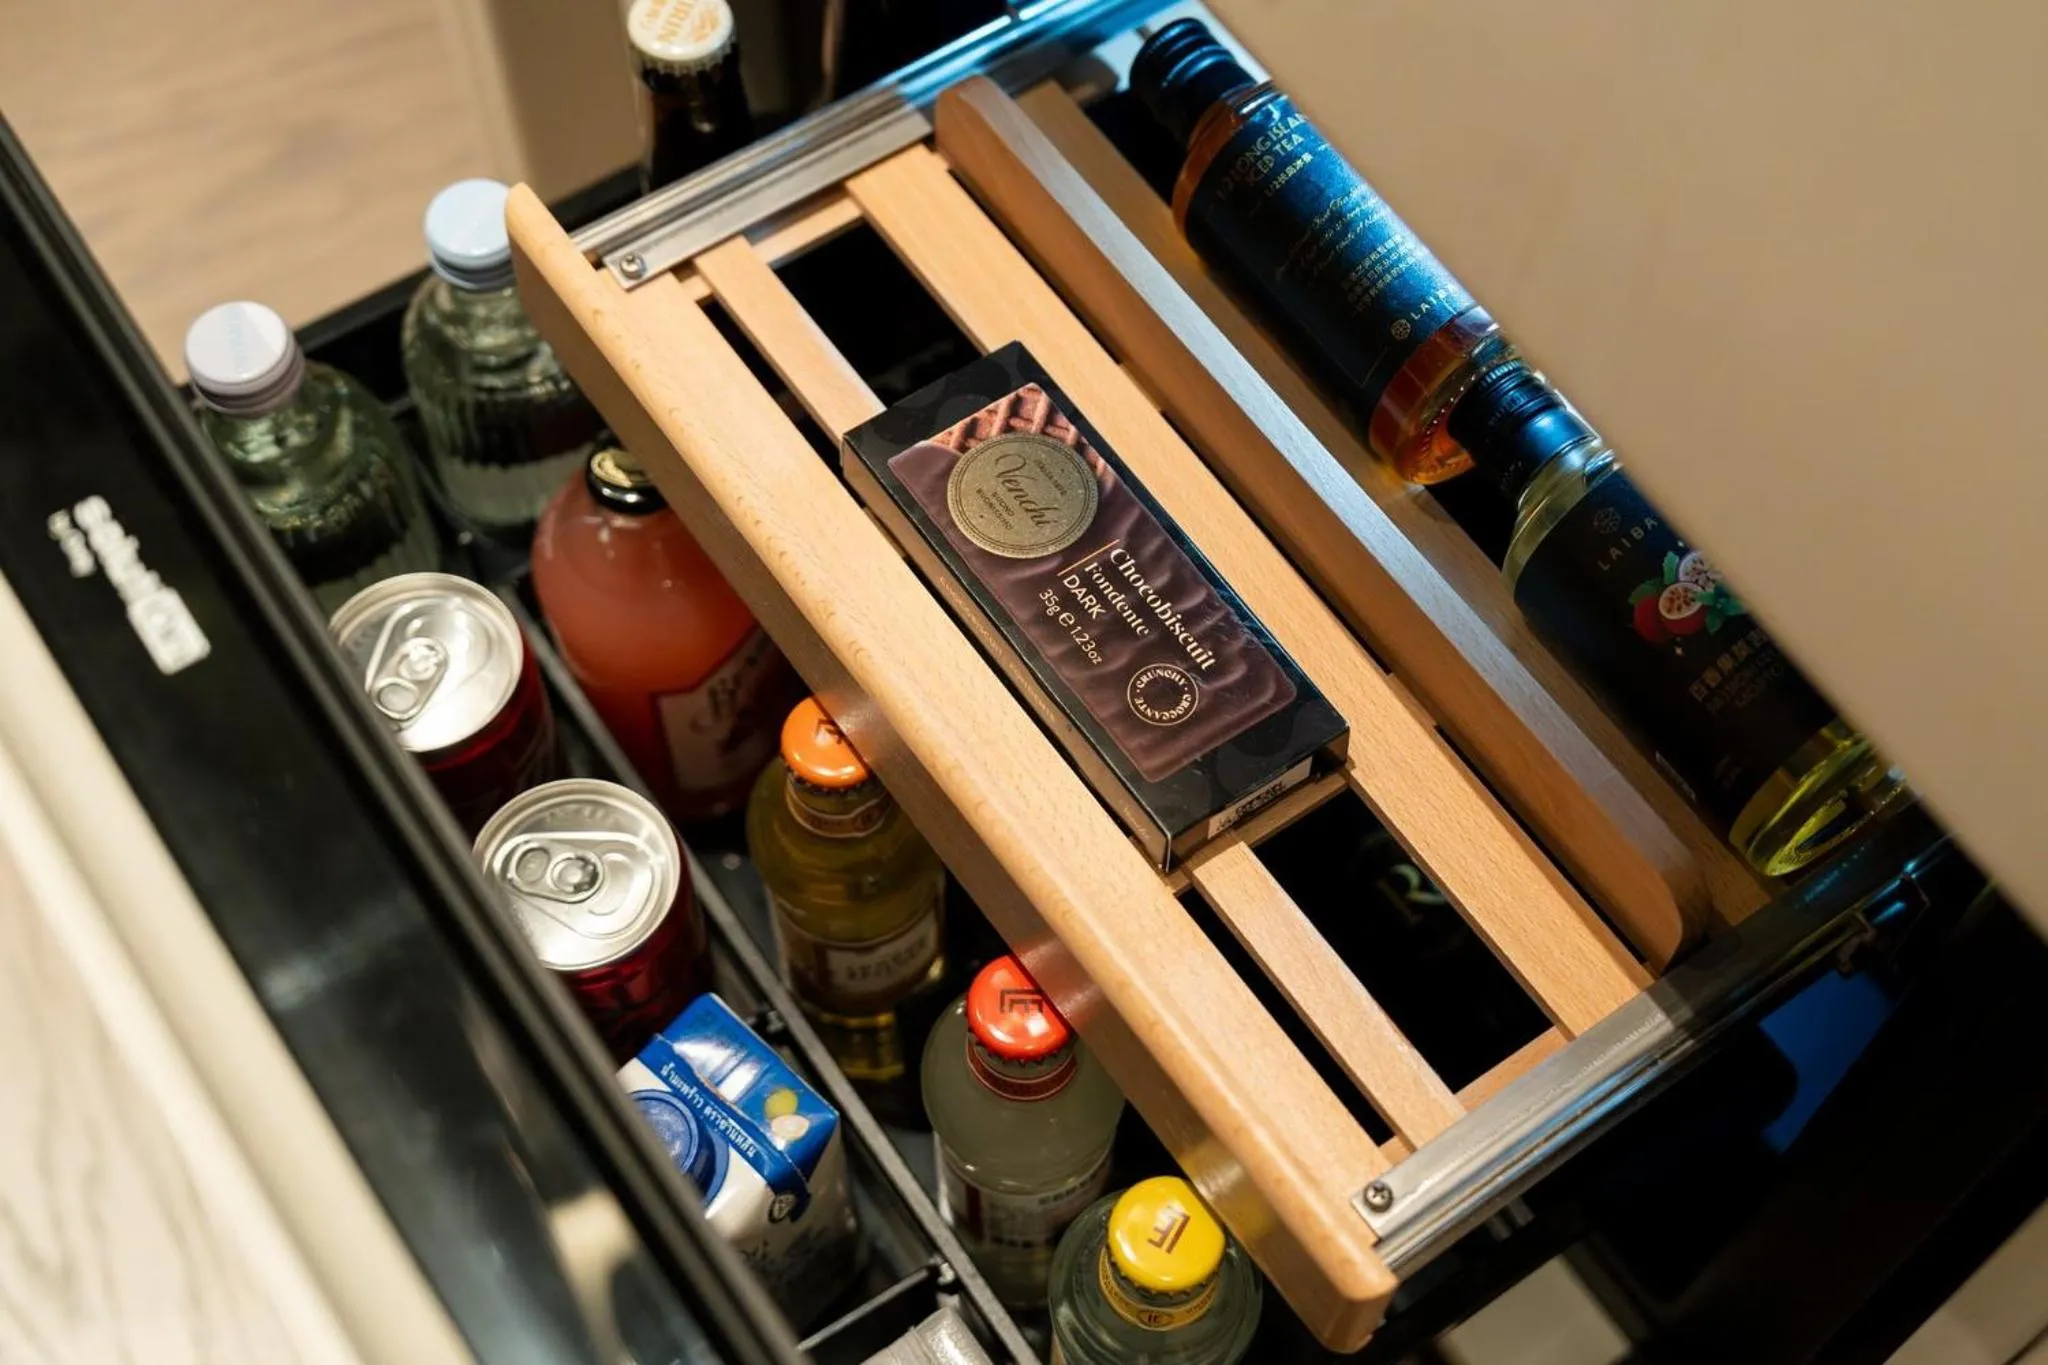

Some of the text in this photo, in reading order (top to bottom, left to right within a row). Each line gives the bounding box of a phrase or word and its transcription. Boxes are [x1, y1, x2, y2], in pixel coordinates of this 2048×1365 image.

[1273, 132, 1304, 156] TEA
[994, 454, 1059, 528] Venchi
[1596, 515, 1658, 571] LAIBA
[1061, 574, 1104, 620] DARK
[1083, 561, 1149, 639] Fondente
[1109, 549, 1215, 671] Chocobiscuit
[1037, 587, 1062, 616] 35g
[1069, 625, 1102, 665] 1.23oz
[1134, 666, 1187, 686] CRUNCHY
[1133, 691, 1190, 720] CROCCANTE
